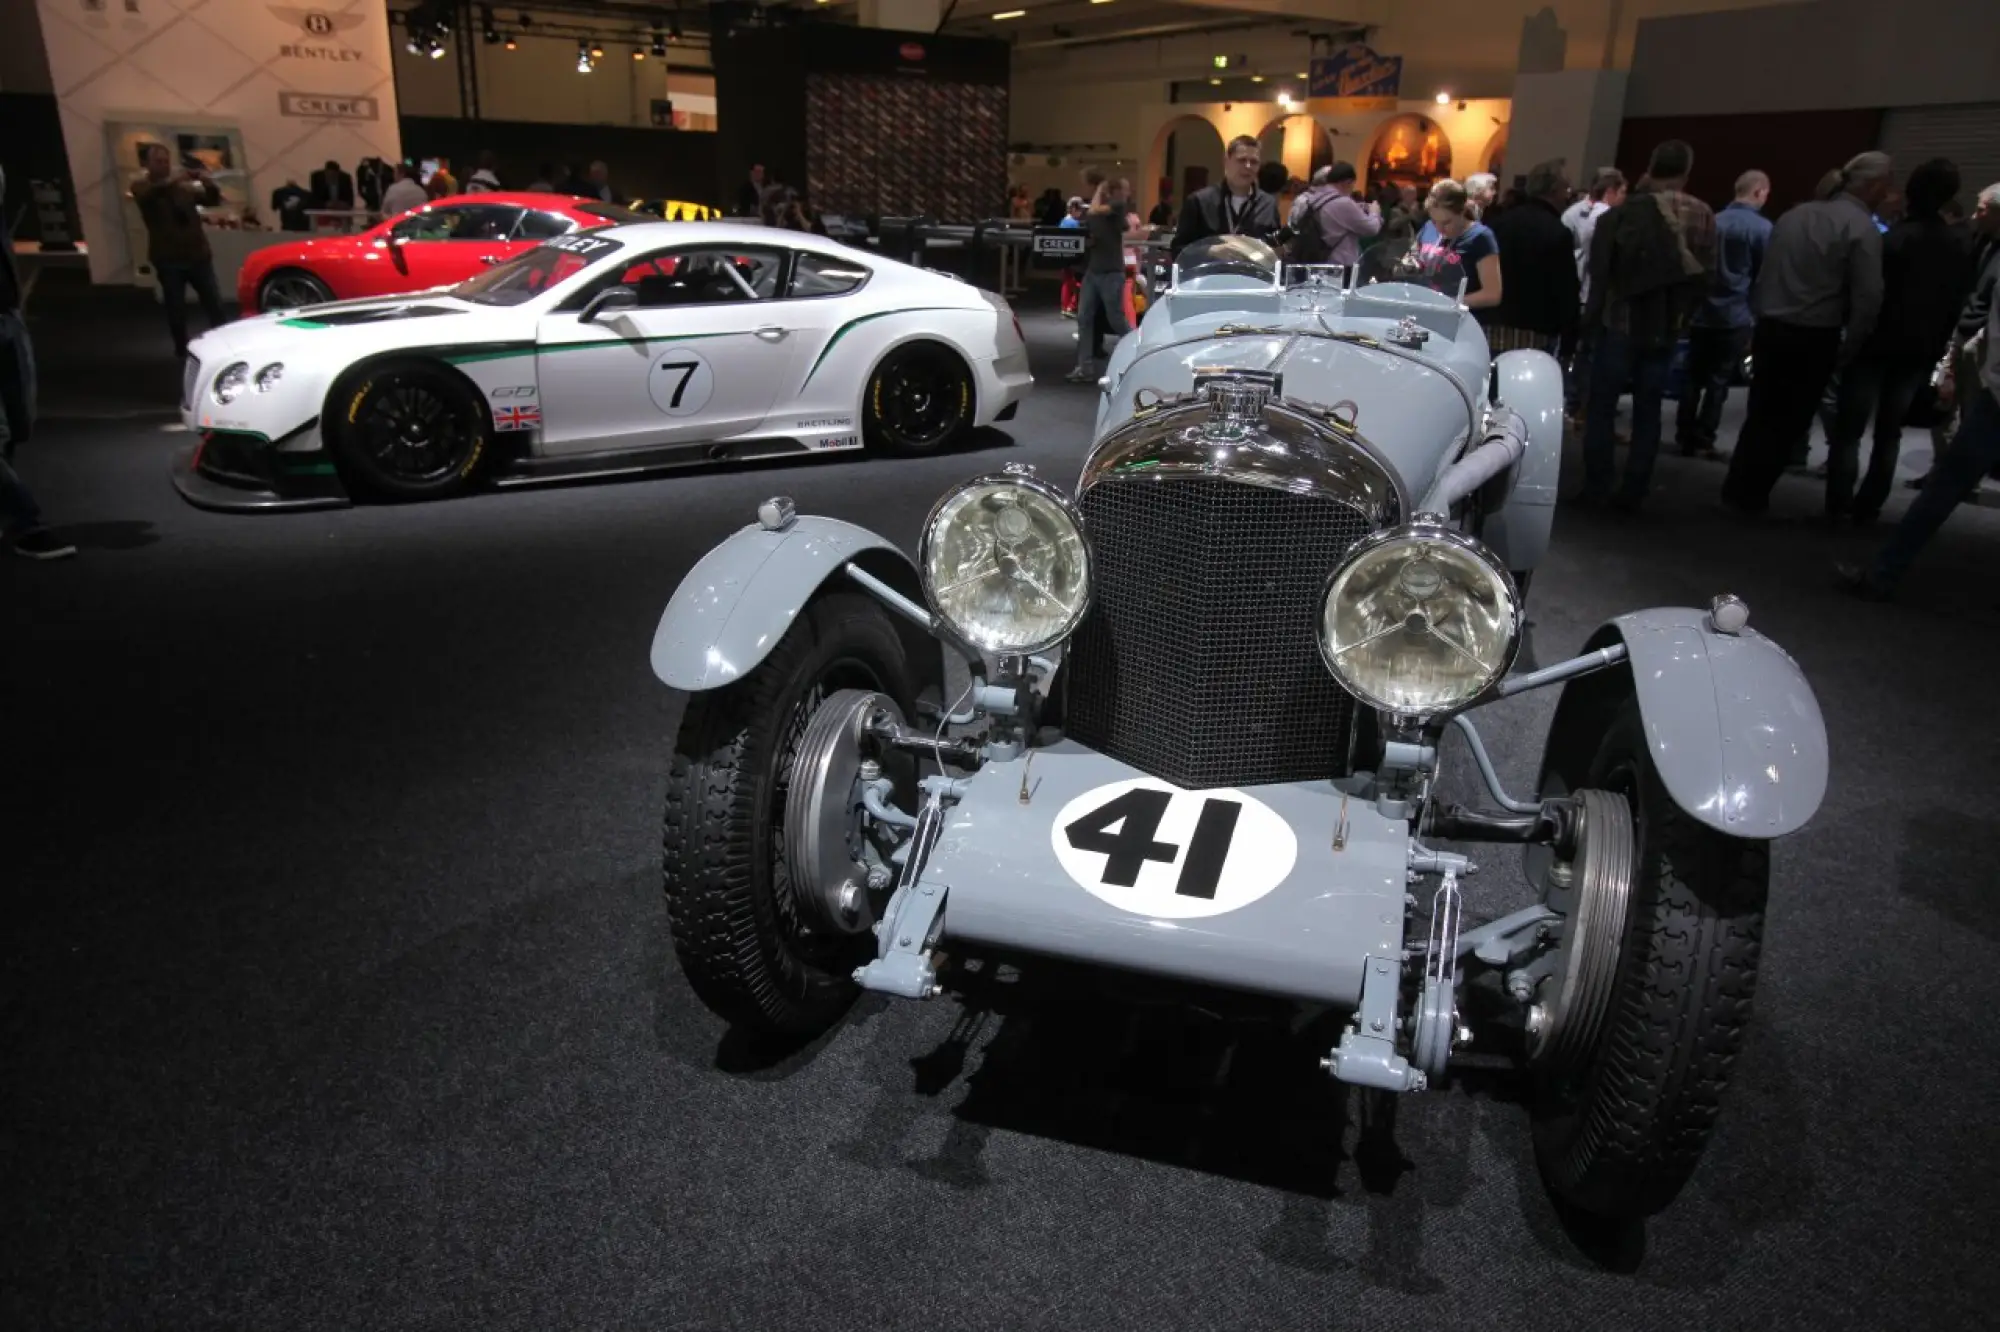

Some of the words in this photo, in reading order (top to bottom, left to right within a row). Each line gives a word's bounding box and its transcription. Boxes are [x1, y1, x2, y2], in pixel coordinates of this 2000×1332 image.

[280, 44, 363, 62] BENTLEY
[296, 100, 360, 115] CREWE
[1043, 239, 1076, 249] CREWE
[661, 361, 700, 409] 7
[820, 436, 848, 448] Mobil
[1064, 788, 1243, 900] 41
